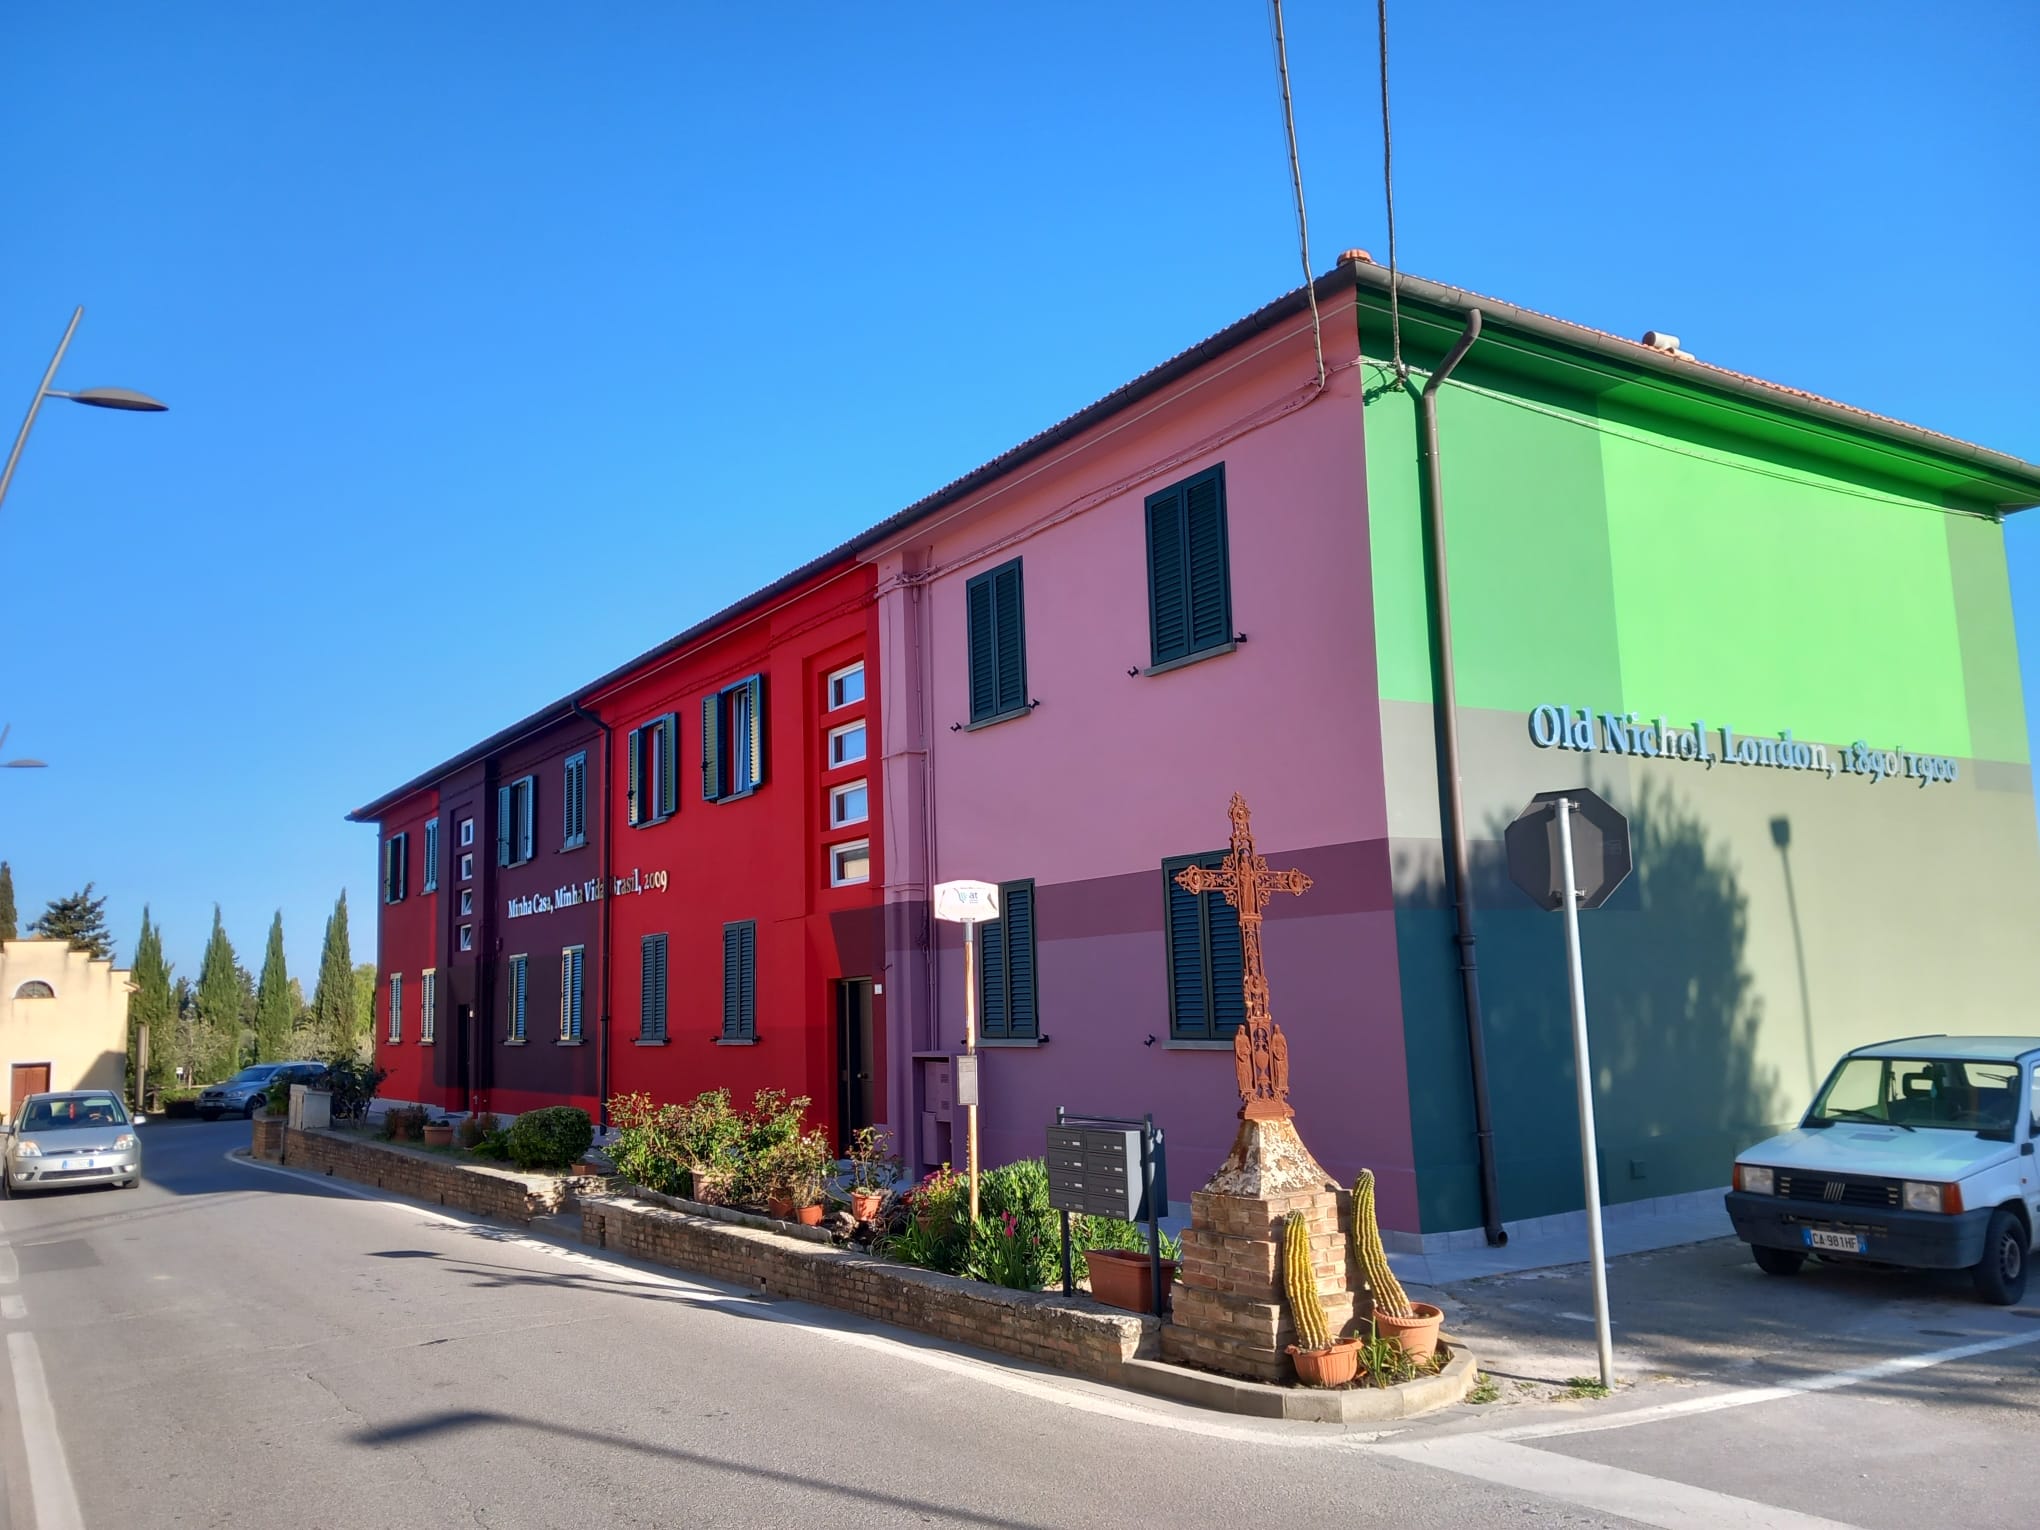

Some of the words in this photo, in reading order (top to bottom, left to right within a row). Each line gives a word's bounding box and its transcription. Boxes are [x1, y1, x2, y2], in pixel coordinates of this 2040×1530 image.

[1530, 703, 1597, 750] Old
[1600, 711, 1717, 768] Nichol,
[1720, 724, 1837, 777] London,
[508, 895, 533, 919] Minha
[533, 893, 554, 914] Casa,
[554, 884, 583, 909] Minha
[643, 870, 668, 893] 2009
